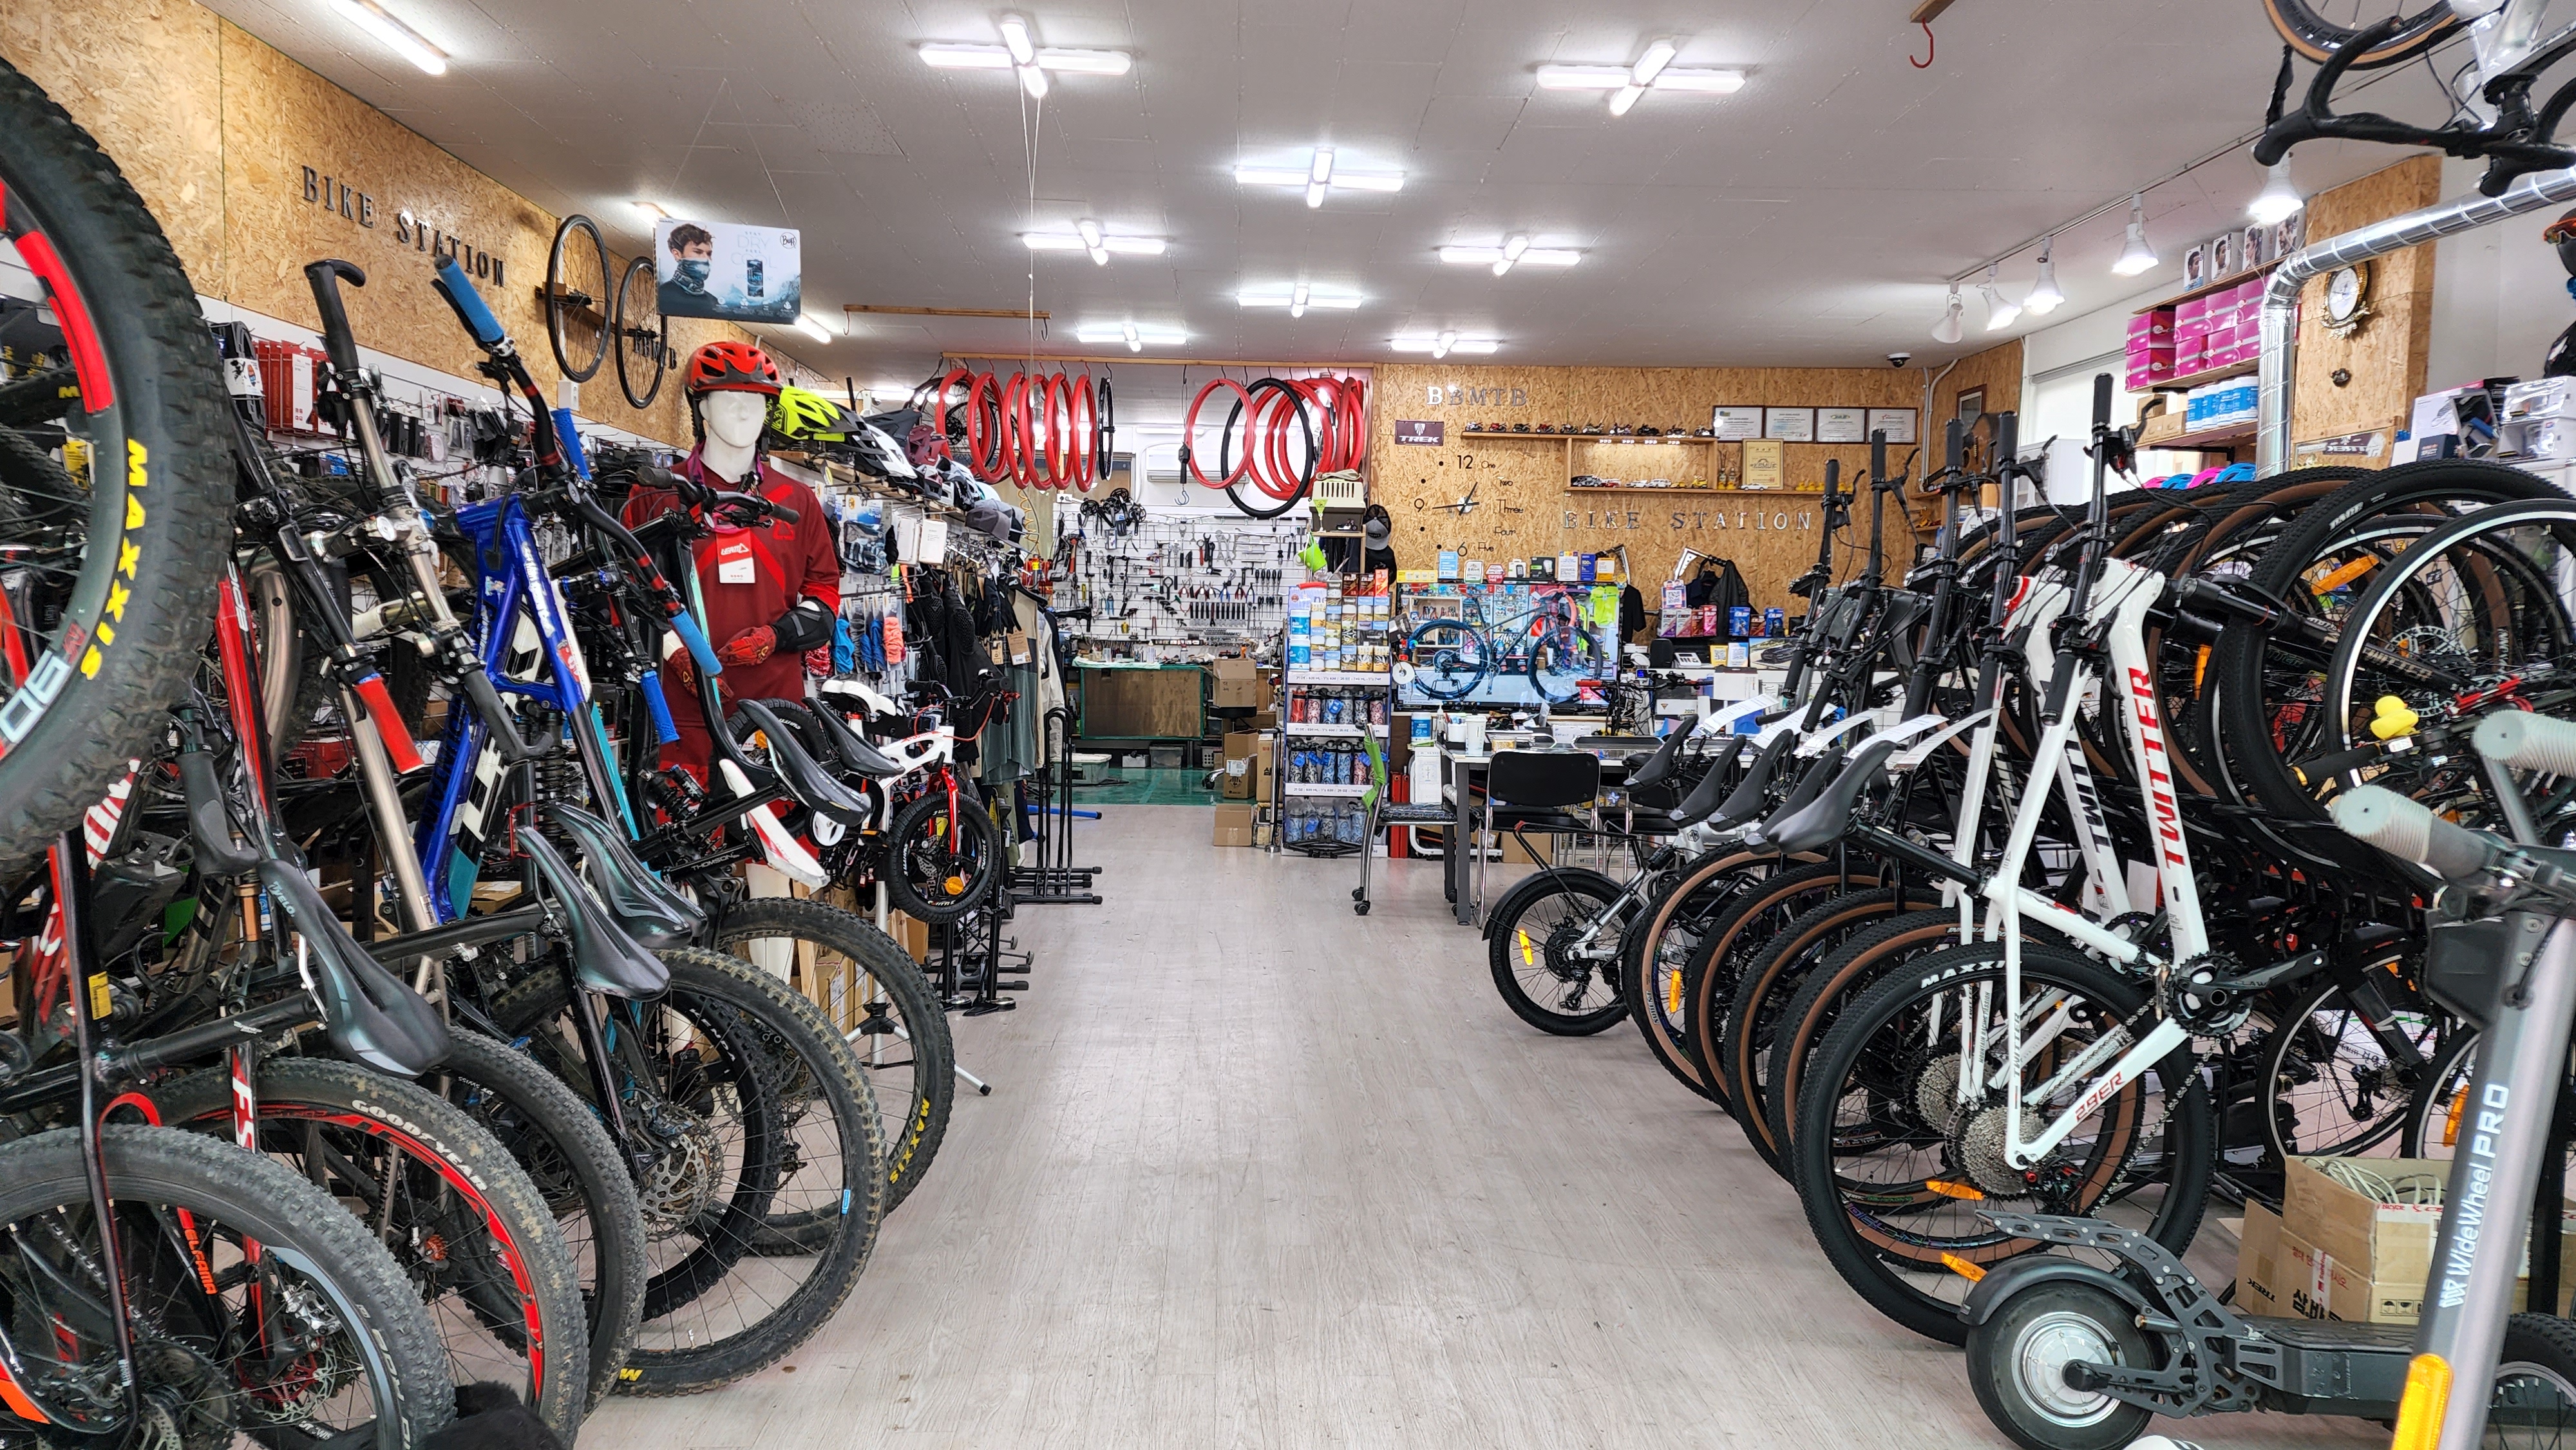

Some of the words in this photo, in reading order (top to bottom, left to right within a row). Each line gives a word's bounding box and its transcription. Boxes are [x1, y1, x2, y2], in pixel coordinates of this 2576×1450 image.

[302, 165, 374, 229] BIKE
[396, 211, 506, 287] STATION
[737, 235, 771, 249] DRY
[1426, 386, 1526, 406] BBMTB
[1457, 455, 1473, 469] 12
[1481, 460, 1496, 469] One
[1497, 476, 1513, 487] Two
[1414, 498, 1425, 513] 9
[1495, 499, 1524, 514] Three
[1493, 526, 1516, 536] Four
[1563, 511, 1640, 529] BIKE
[1671, 512, 1812, 530] STATION
[1457, 541, 1468, 557] 6
[1477, 542, 1494, 552] Five
[80, 438, 147, 681] MAXXIS
[2362, 646, 2434, 681] TWITTER
[2127, 667, 2186, 869] TWITTER
[691, 854, 734, 873] THOMSON
[1921, 960, 2022, 989] MAXXI
[688, 1008, 737, 1063] KENDA
[2074, 1071, 2126, 1123] 29ER
[352, 1098, 488, 1192] GOODYEAR
[889, 1098, 930, 1185] MAXXIS
[2446, 1162, 2493, 1277] WideWheel
[2472, 1082, 2510, 1159] PRO
[184, 1228, 217, 1295] ELFAMA
[2247, 1277, 2276, 1303] TREK
